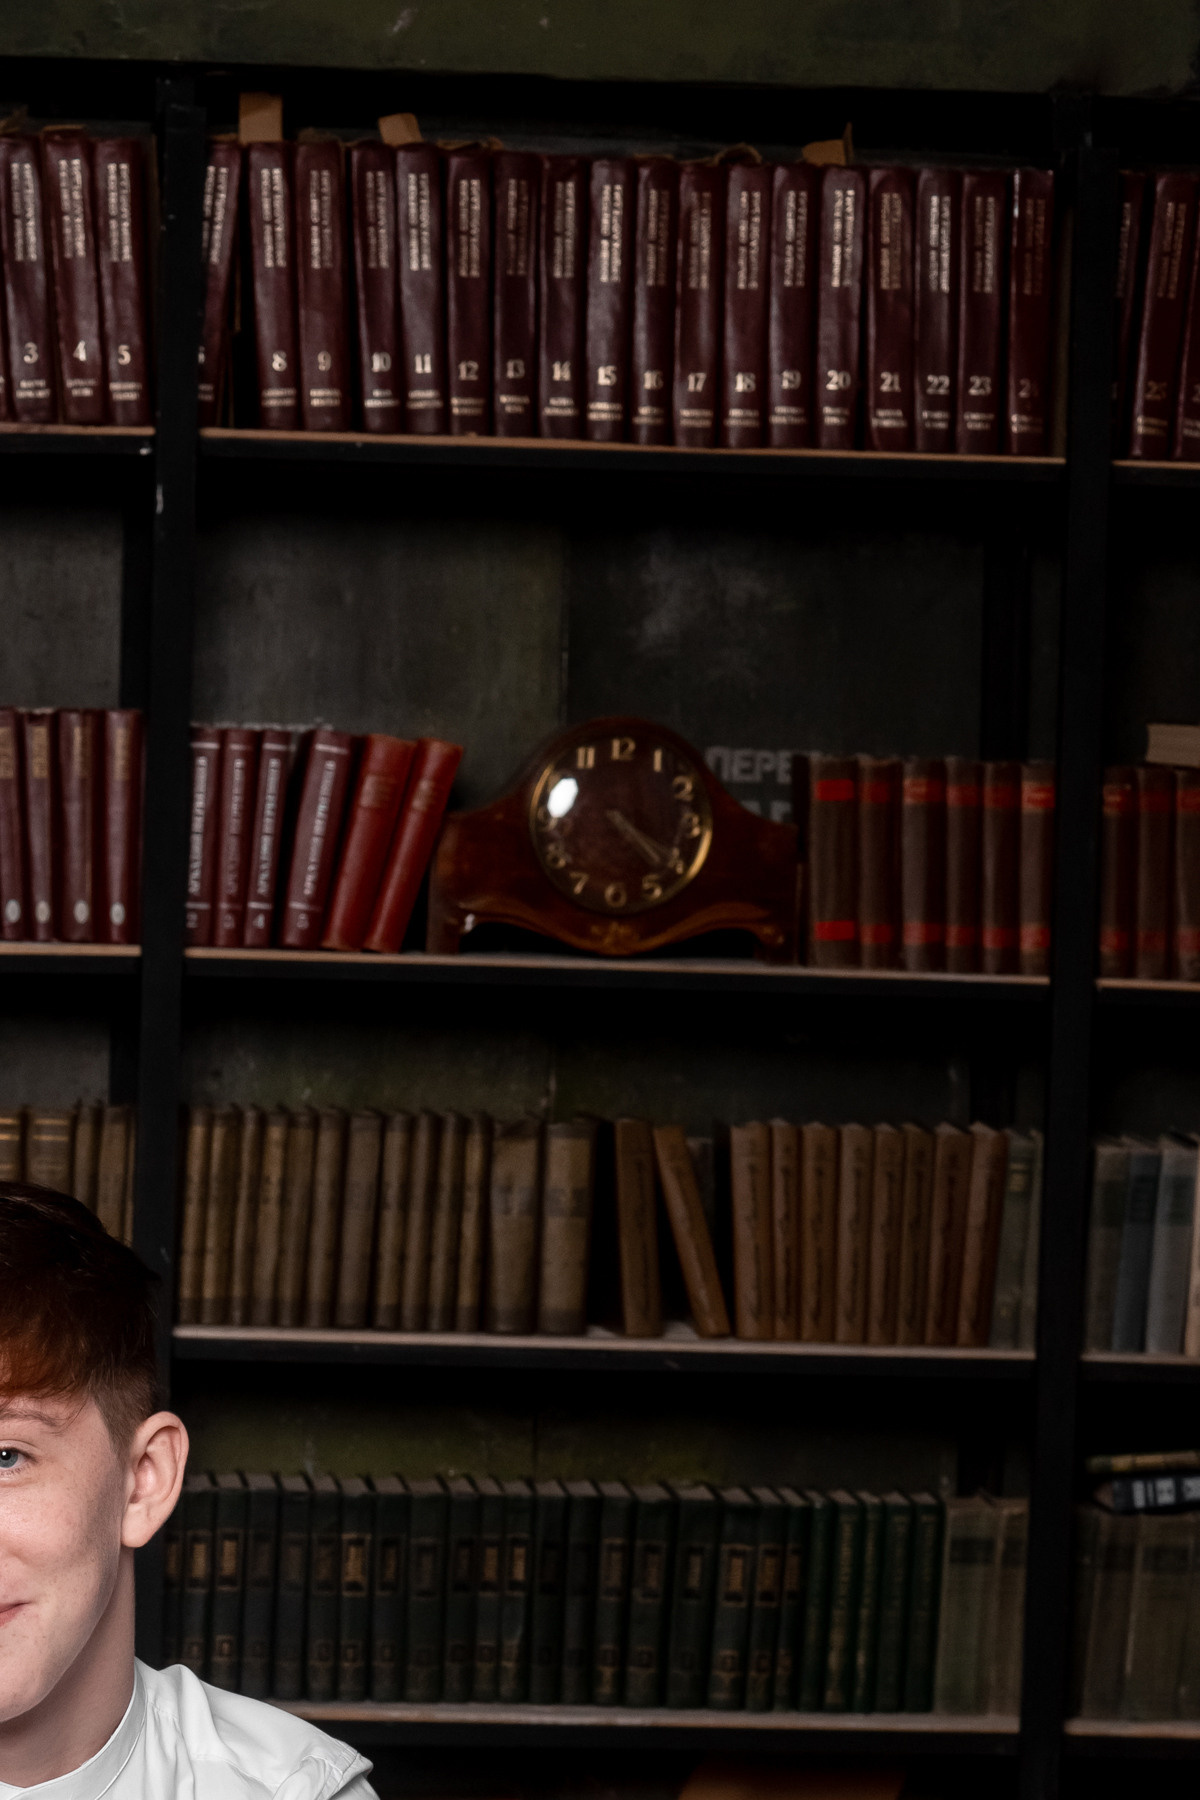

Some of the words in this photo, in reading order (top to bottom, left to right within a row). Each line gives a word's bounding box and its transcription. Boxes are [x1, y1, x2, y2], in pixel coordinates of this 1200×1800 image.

[23, 341, 40, 364] 3
[72, 340, 88, 362] 4
[116, 344, 131, 366] 5
[266, 350, 288, 372] 8
[317, 350, 332, 371] 9
[370, 351, 392, 373] 10
[413, 353, 432, 374] 11
[457, 361, 480, 381] 12
[505, 358, 526, 379] 13
[551, 360, 572, 382] 14
[596, 365, 618, 386] 15
[687, 372, 707, 393] 17
[734, 372, 757, 393] 18
[780, 369, 802, 390] 19
[825, 370, 852, 392] 20
[879, 371, 902, 393] 21
[926, 374, 951, 395] 22
[968, 375, 992, 396] 23
[576, 745, 596, 770] 11
[610, 737, 637, 761] 12
[653, 748, 663, 773] 1
[672, 775, 694, 801] 2
[569, 871, 590, 895] 7
[642, 873, 663, 900] 5
